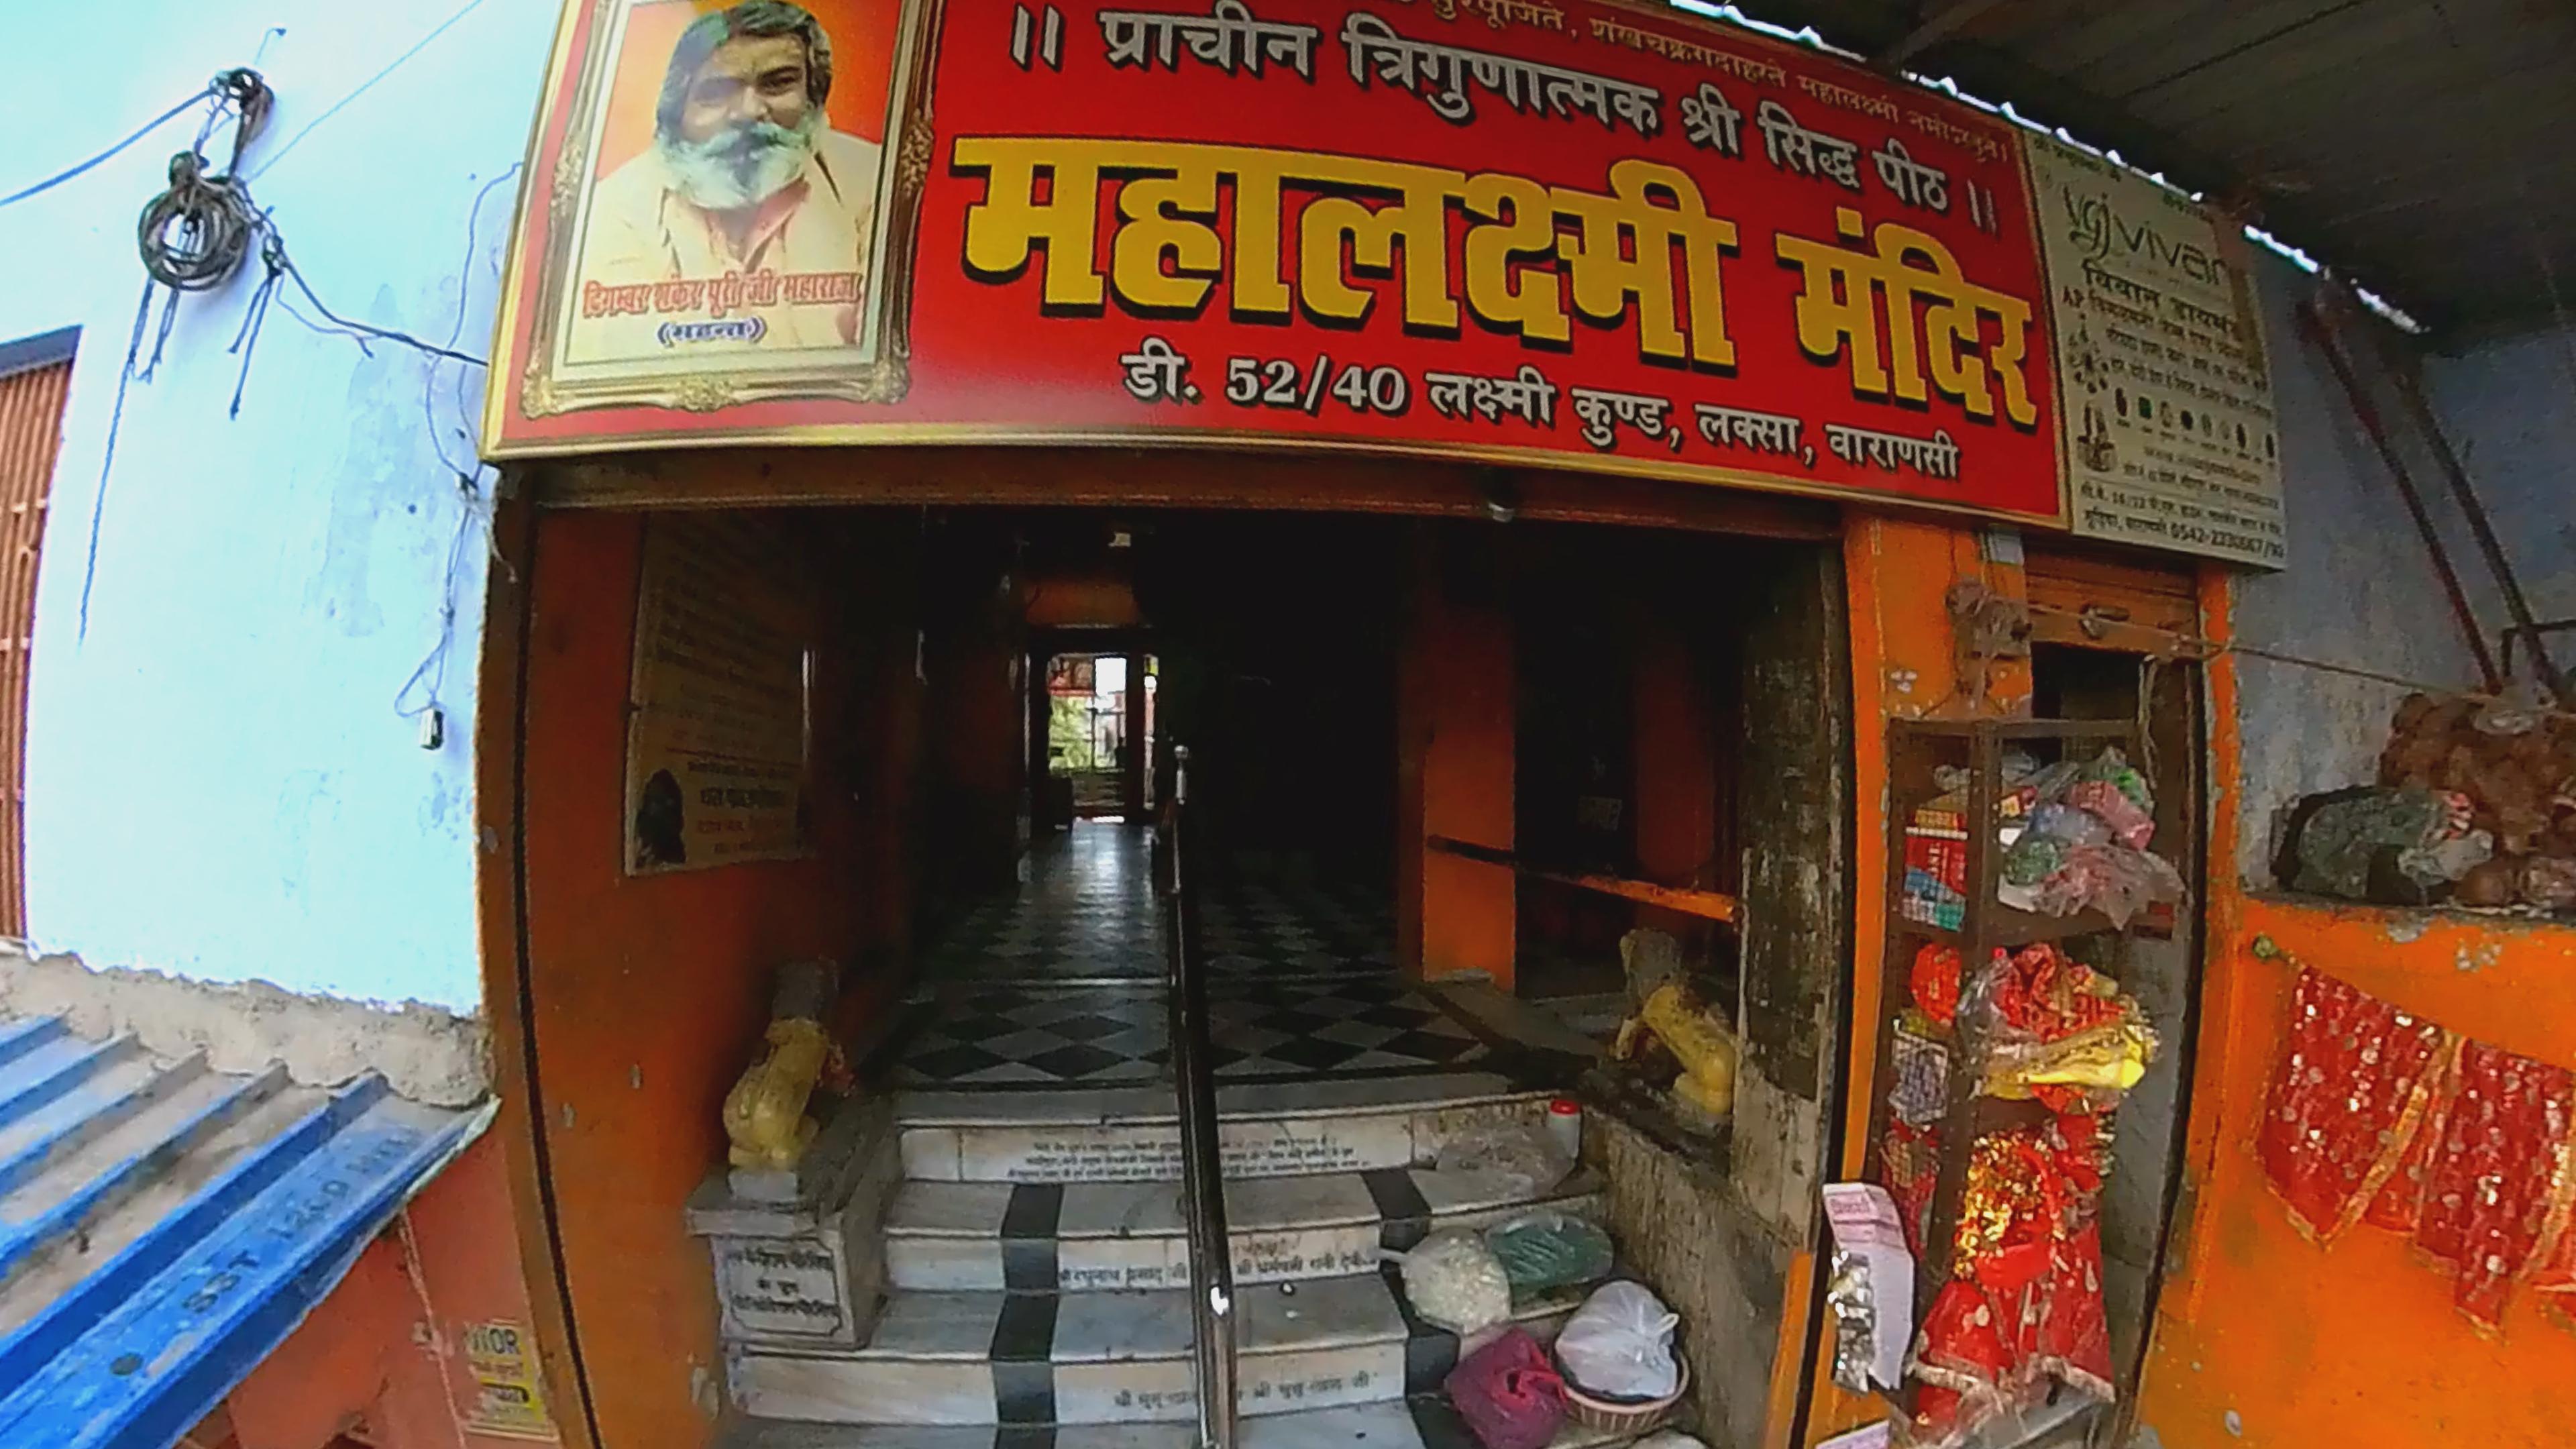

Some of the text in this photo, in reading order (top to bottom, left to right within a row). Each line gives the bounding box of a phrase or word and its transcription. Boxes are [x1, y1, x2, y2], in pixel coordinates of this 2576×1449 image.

[1099, 0, 1319, 76] प्राचीन
[1341, 12, 1659, 133] त्रिगुणात्मक
[1680, 83, 1740, 154] श्री
[1757, 100, 1860, 188] सिद्ध
[1872, 138, 1947, 211] पीठ
[953, 136, 2037, 426] महालक्ष्मी मंदिर
[1121, 337, 1960, 478] डी. 52/40 लक्ष्मी कुण्ड, लक्सा, वाराणसी
